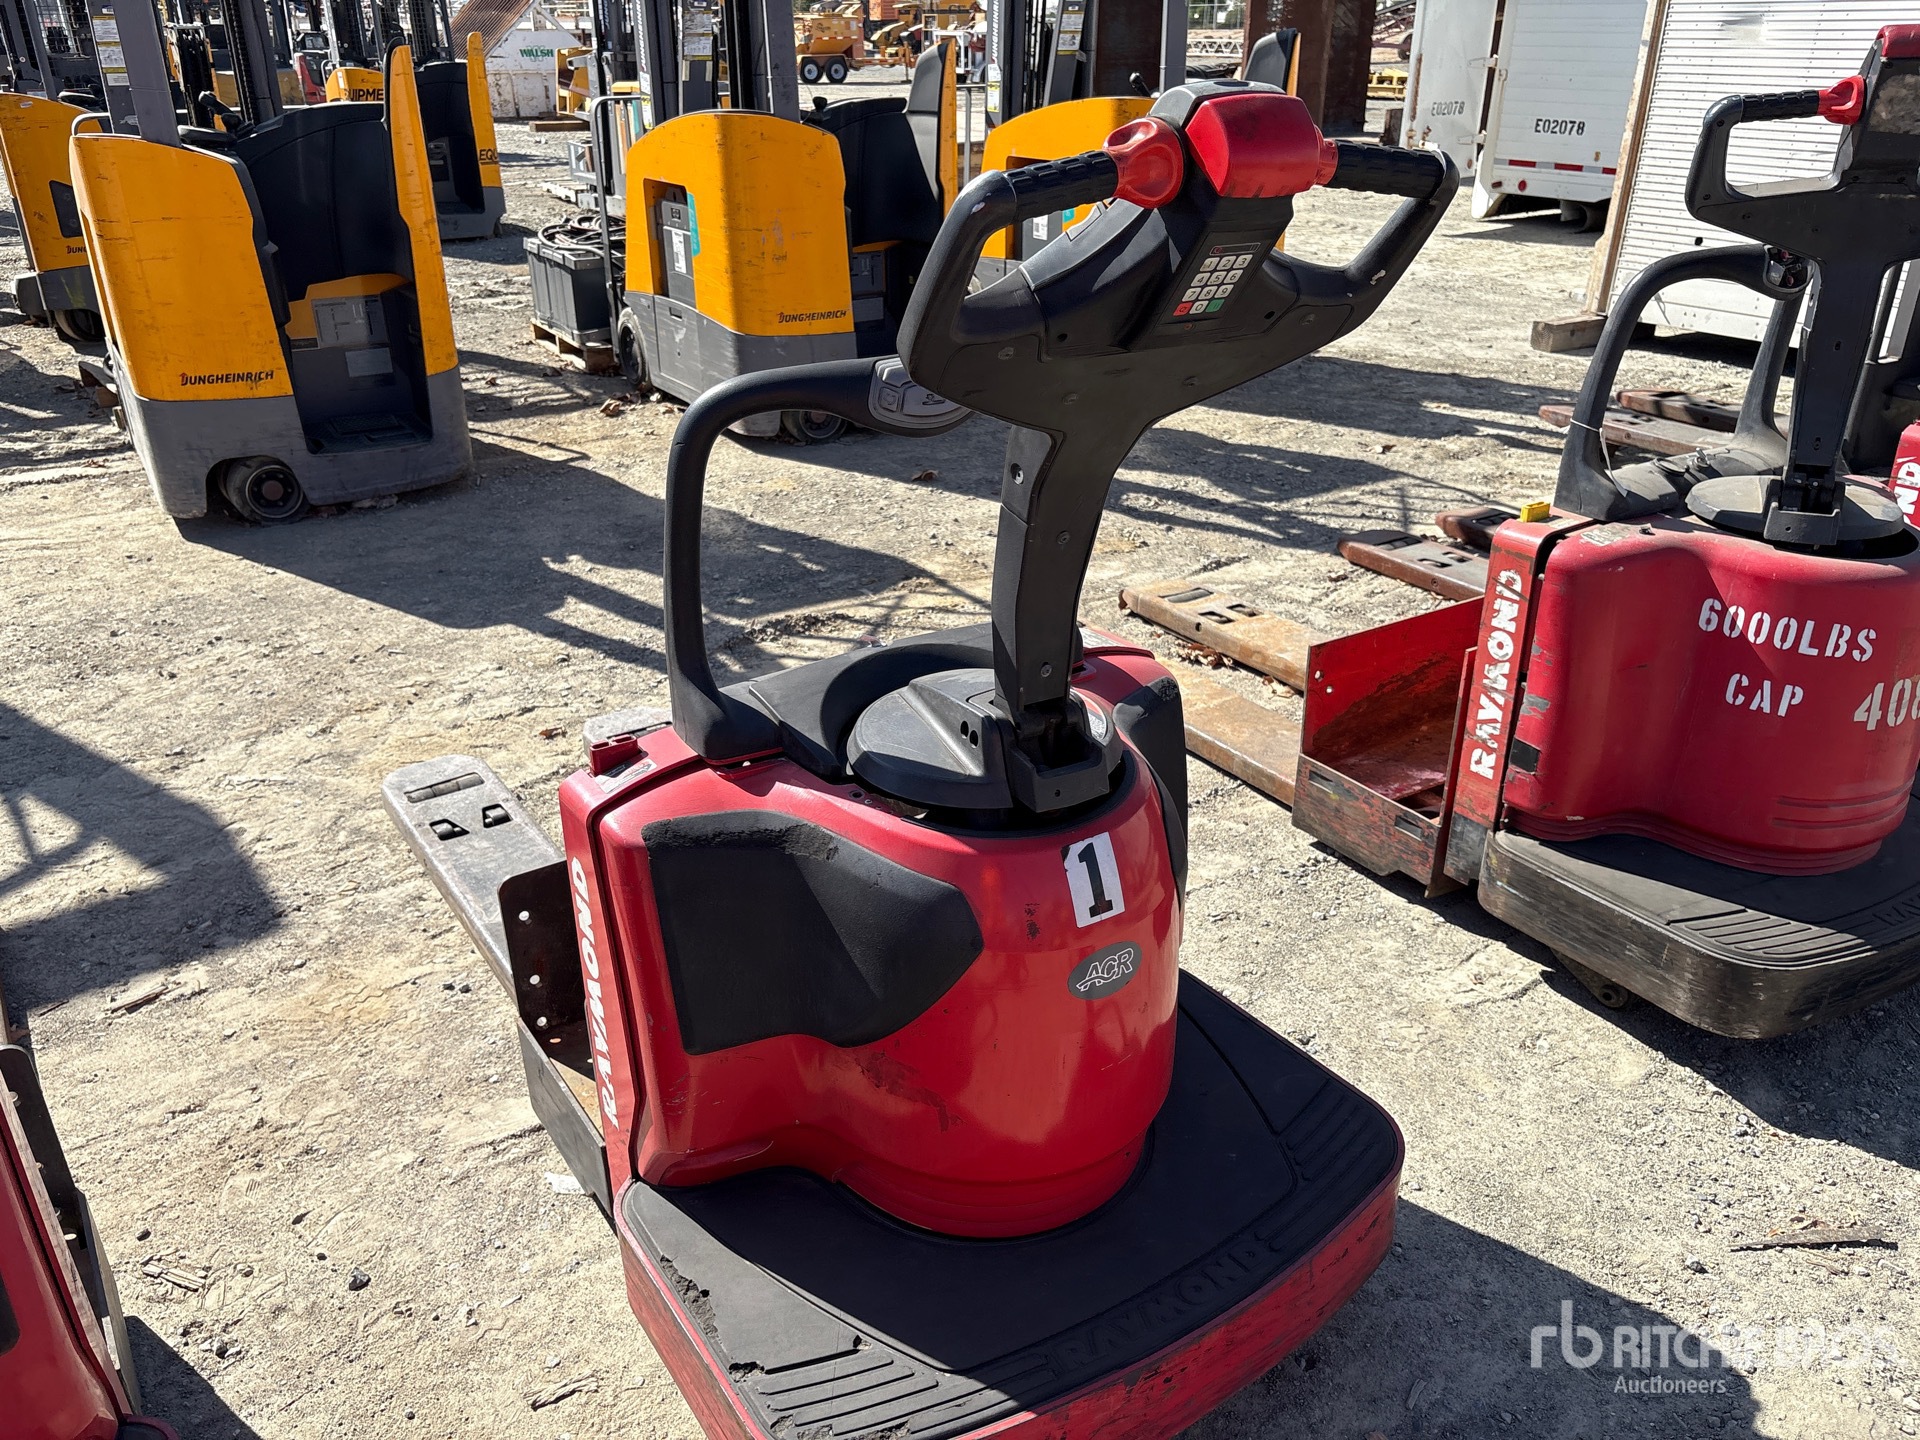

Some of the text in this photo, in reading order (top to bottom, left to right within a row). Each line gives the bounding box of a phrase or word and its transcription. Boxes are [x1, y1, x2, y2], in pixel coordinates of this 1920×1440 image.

[519, 49, 554, 58] WALSH
[1431, 101, 1465, 117] E02078
[1534, 118, 1586, 136] E02078
[777, 310, 847, 324] JUNGHEINRICH
[180, 370, 274, 386] JUNGHEINRICH
[1698, 598, 1877, 662] 6000LBS
[1469, 569, 1522, 780] RAYMOND
[1725, 673, 1804, 717] CAP
[1078, 842, 1113, 918] 1
[1076, 947, 1134, 992] ACR
[571, 856, 620, 1130] RAYMOND
